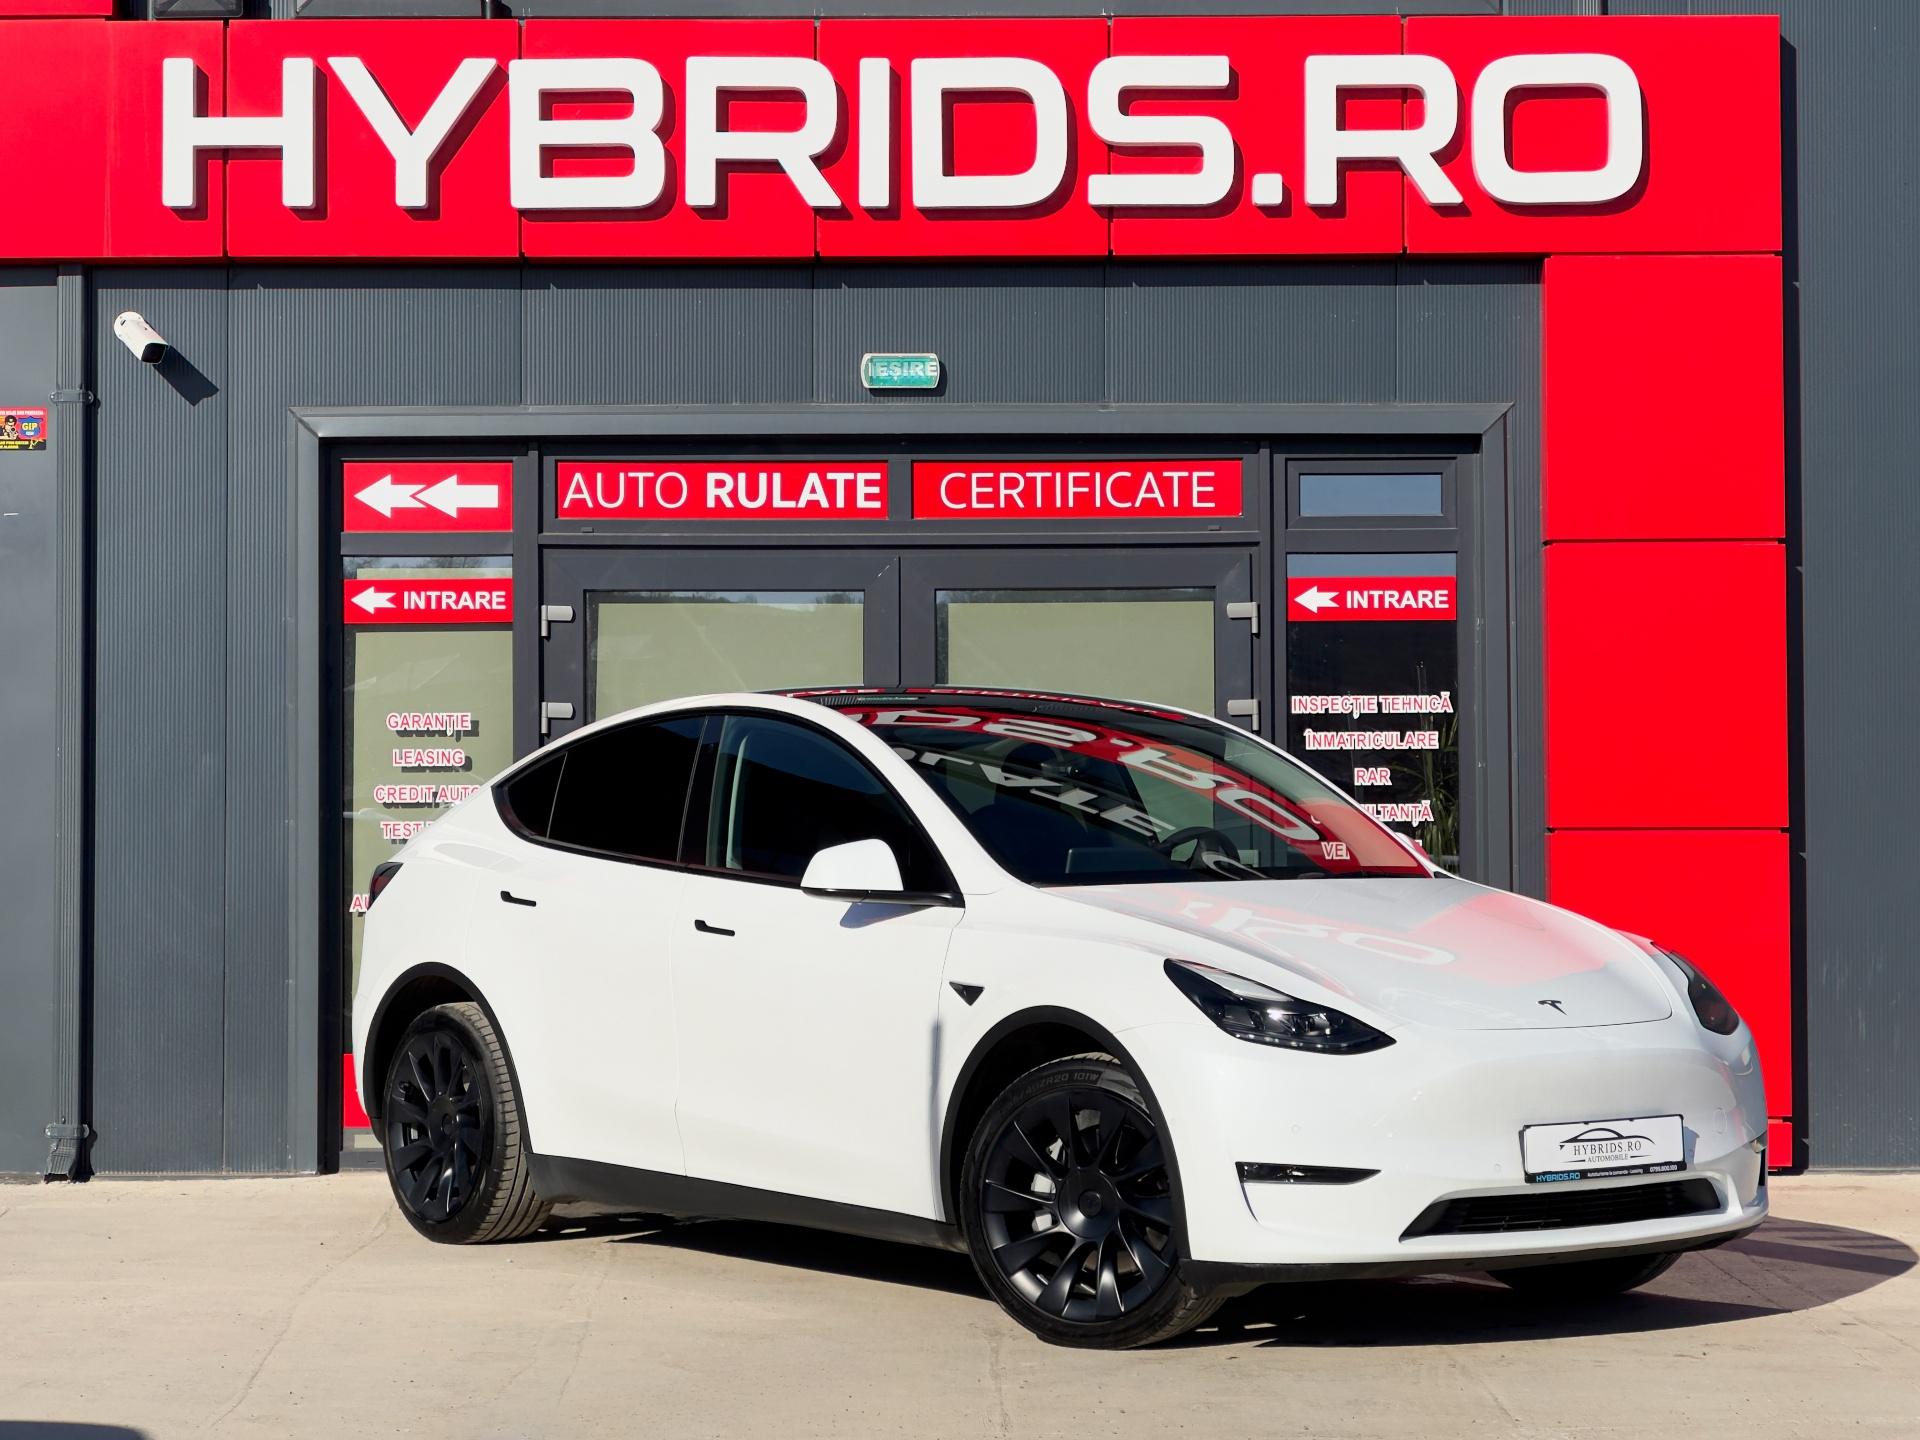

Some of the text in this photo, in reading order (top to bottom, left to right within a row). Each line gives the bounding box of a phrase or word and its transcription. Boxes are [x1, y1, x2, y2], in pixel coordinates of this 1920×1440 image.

[162, 53, 1644, 211] HYBRIDS.RO
[21, 422, 38, 431] GIP
[563, 471, 883, 511] AUTO RULATE
[940, 471, 1217, 511] CERTIFICATE
[403, 591, 508, 612] INTRARE
[1346, 590, 1451, 611] INTRARE
[1292, 692, 1453, 719] INSPECȚIE TEHNICĂ
[387, 713, 471, 736] GARANȚIE
[1305, 729, 1439, 750] ÎNMATRICULARE
[393, 750, 464, 766] LEASING
[1354, 768, 1392, 786] RAR
[374, 786, 435, 803] CREDIT
[381, 822, 422, 838] TEST
[1573, 1141, 1642, 1156] HYBRIDS.RO
[1587, 1153, 1629, 1163] AUTOMOBILE
[1535, 1171, 1581, 1183] HYBRIDS.RO
